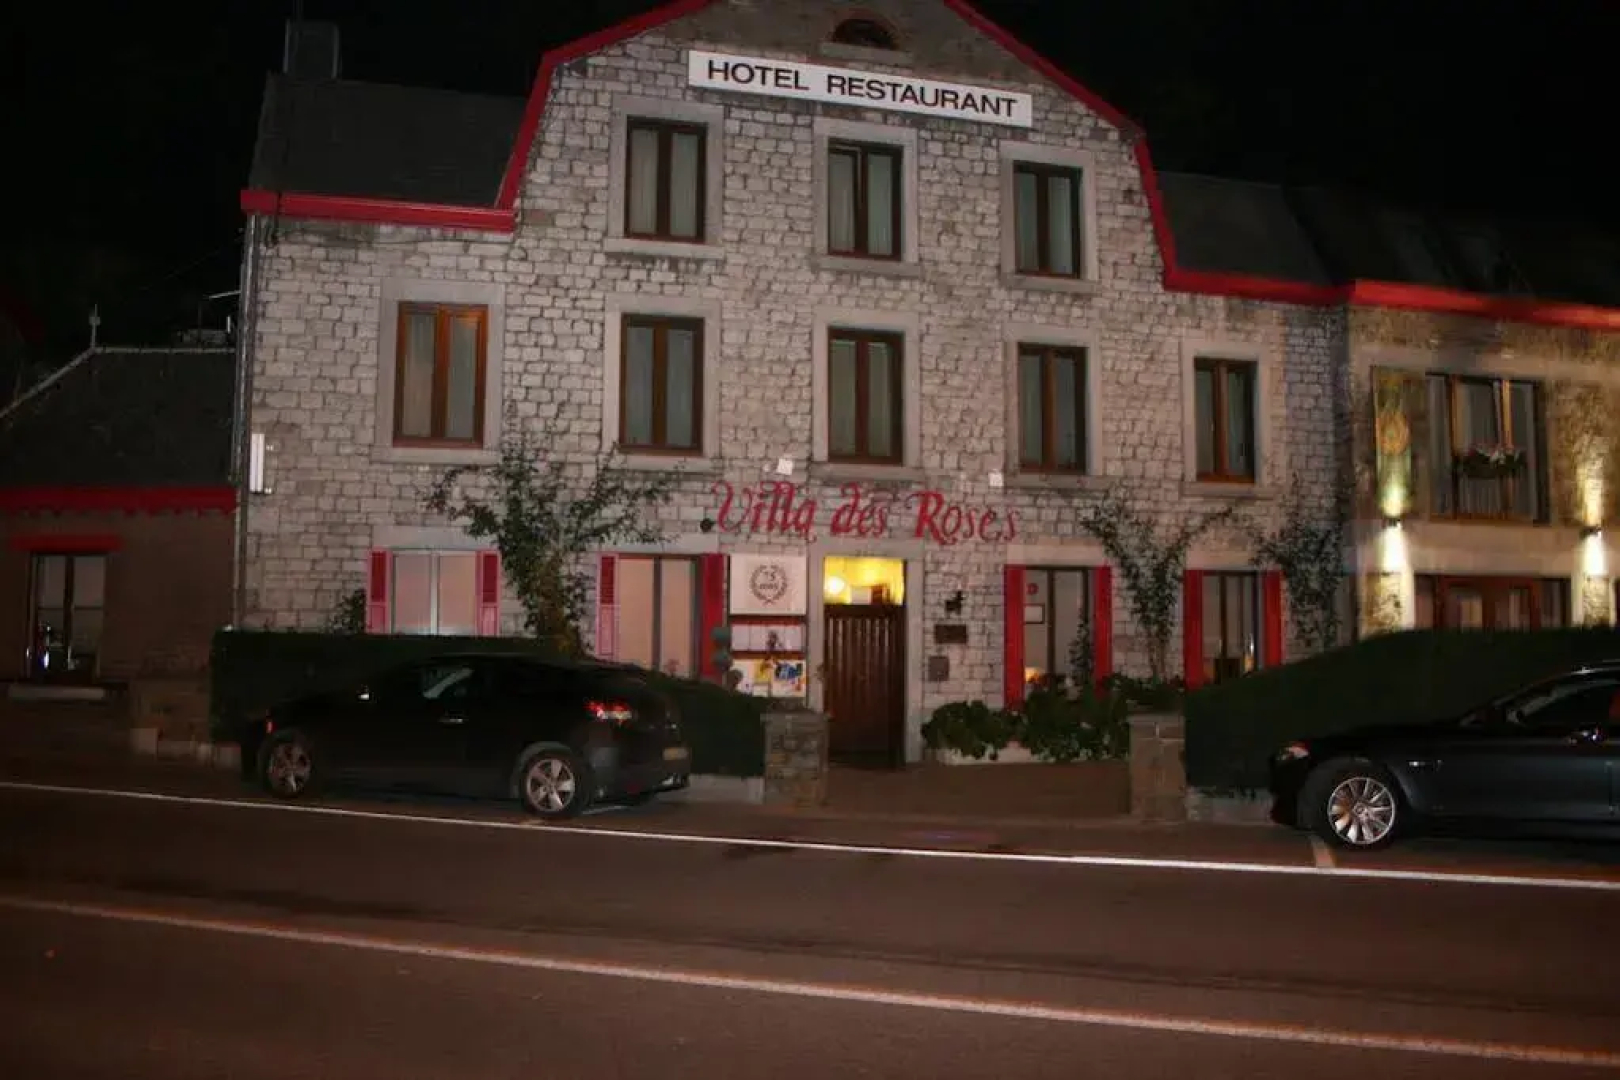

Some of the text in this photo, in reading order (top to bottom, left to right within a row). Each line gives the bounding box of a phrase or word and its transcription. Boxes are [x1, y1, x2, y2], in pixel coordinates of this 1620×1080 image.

[708, 60, 1017, 118] HOTEL RESTAURANT
[712, 480, 1021, 546] Villa des Roses
